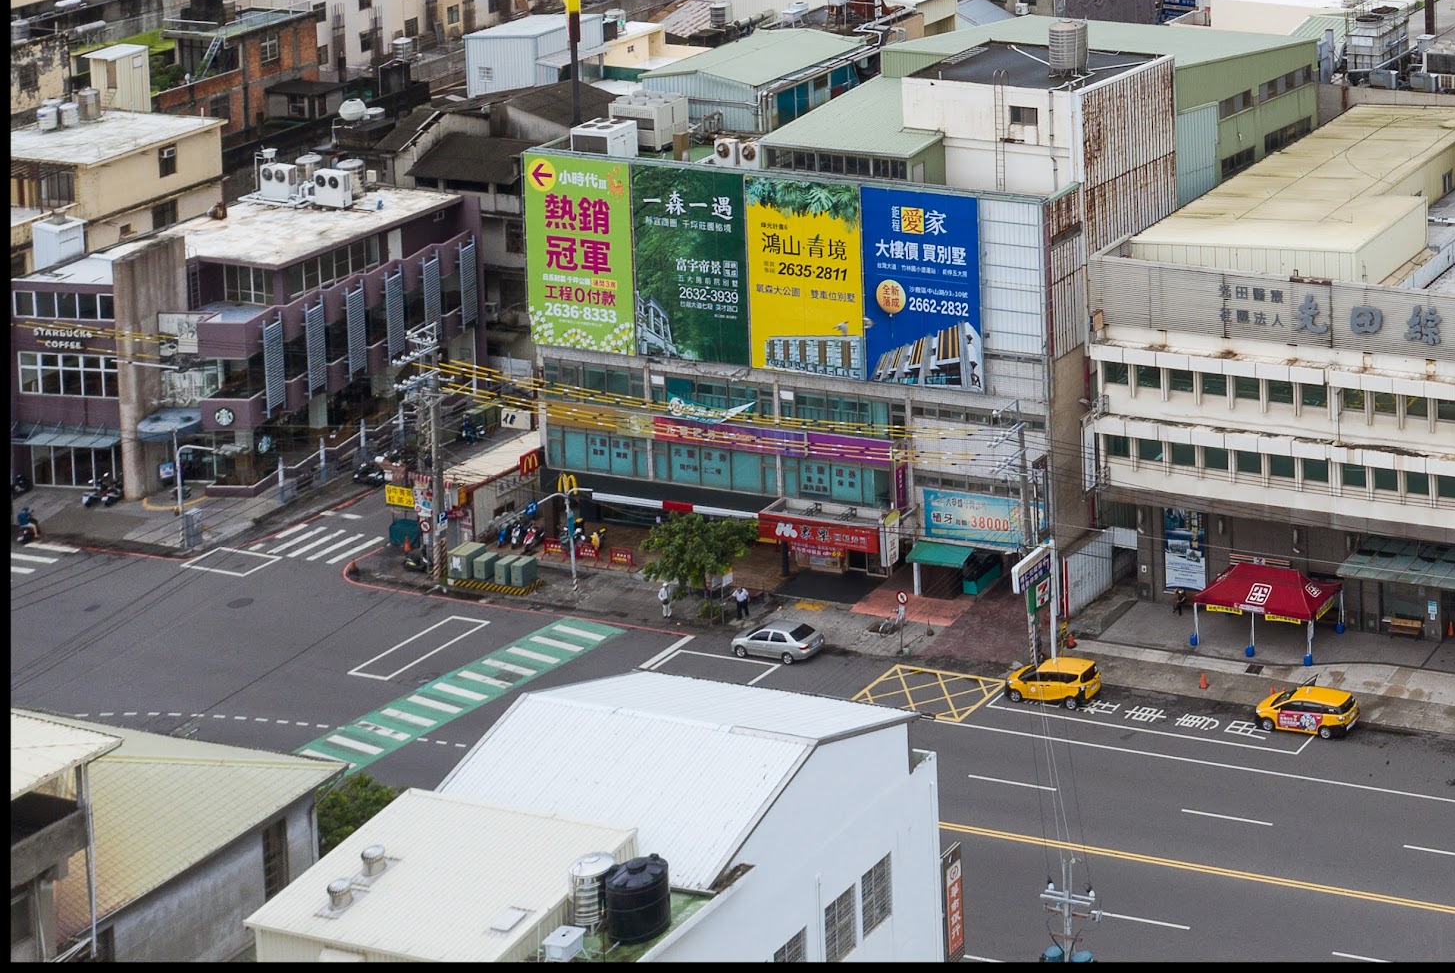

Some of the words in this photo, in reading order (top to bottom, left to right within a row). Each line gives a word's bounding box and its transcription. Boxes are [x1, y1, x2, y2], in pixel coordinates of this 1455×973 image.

[545, 193, 610, 235] 熱銷
[643, 190, 733, 221] 一森一遇
[901, 207, 948, 236] 愛家
[546, 235, 611, 275] 冠軍
[875, 239, 919, 262] 大樓價
[922, 244, 967, 266] 買別墅
[676, 257, 722, 275] 富宇帝景
[679, 287, 738, 303] 2632-3939
[811, 289, 856, 303] 雙車位別墅
[882, 285, 899, 296] 全新
[1219, 285, 1283, 303] 光田醫療
[883, 296, 900, 308] 落成
[909, 297, 969, 317] 2662-2832
[545, 302, 617, 323] 2636-8333
[33, 327, 93, 338] STARBUCKS
[45, 340, 81, 349] COFFEE
[971, 515, 1010, 532] 38000
